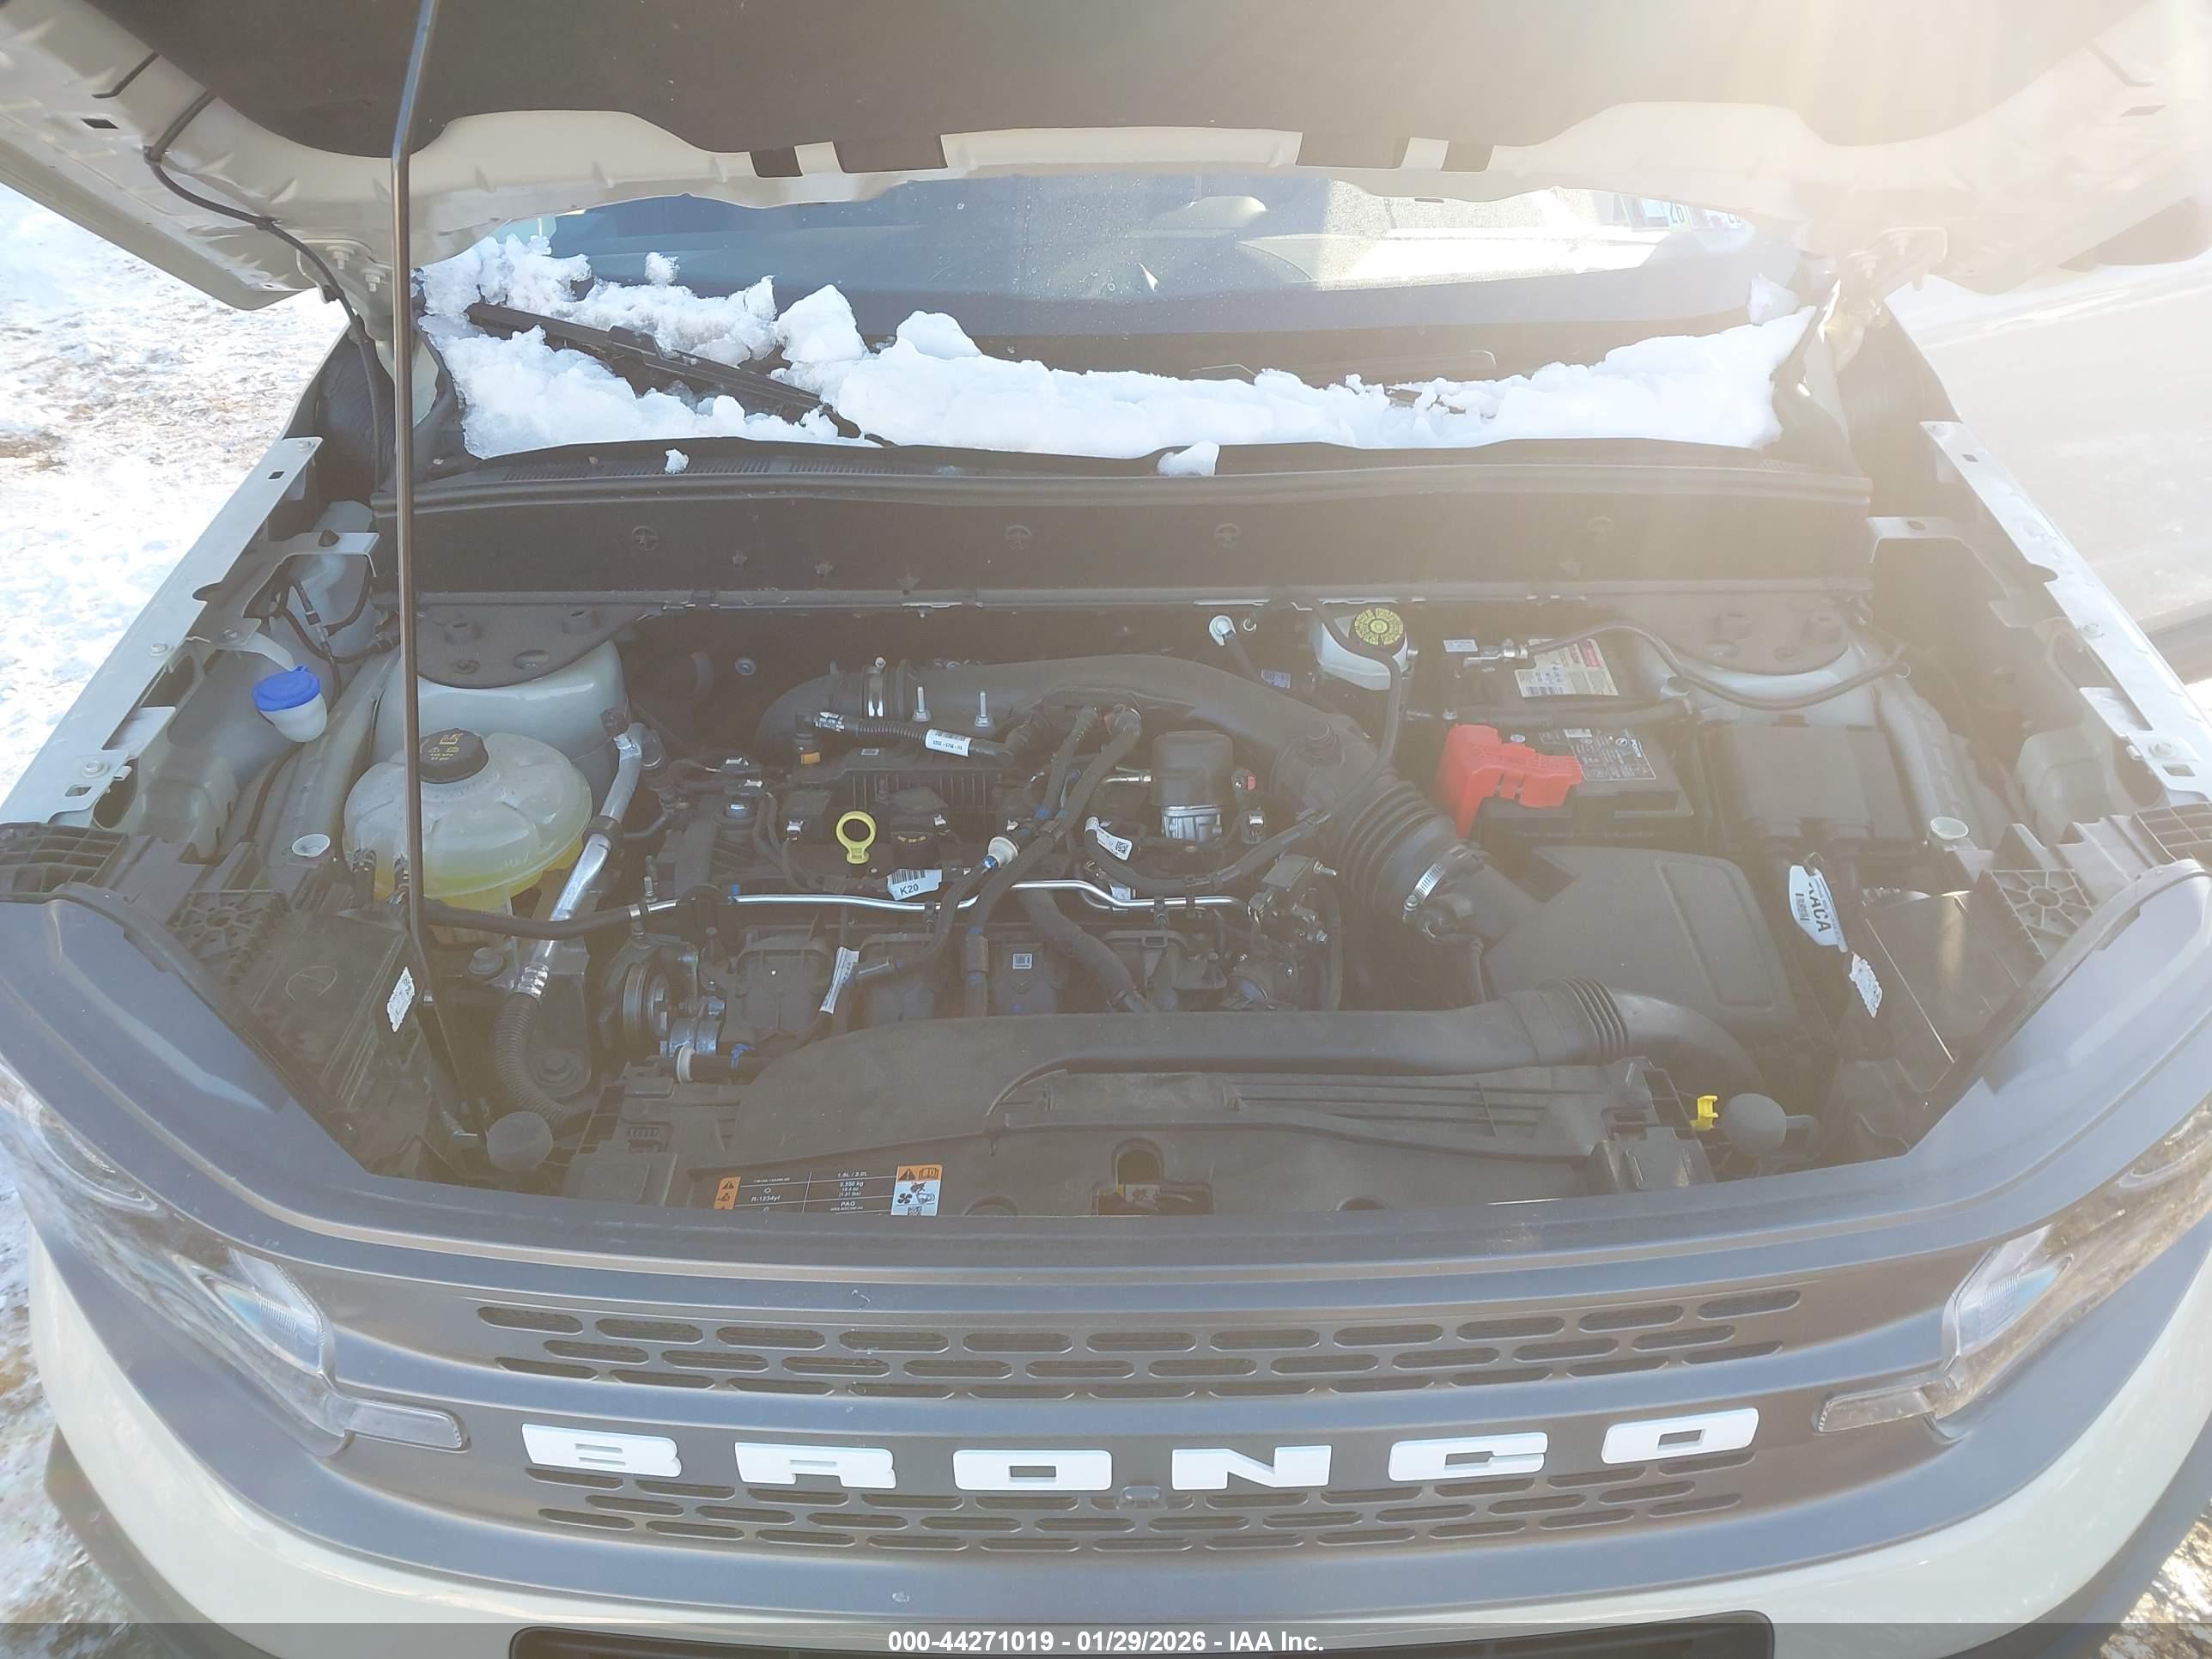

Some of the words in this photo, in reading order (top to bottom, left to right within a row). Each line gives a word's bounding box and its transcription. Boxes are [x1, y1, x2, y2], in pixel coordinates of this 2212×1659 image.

[900, 884, 919, 896] K20
[750, 1194, 781, 1203] R-1234yf
[521, 1407, 1760, 1492] BRONCO
